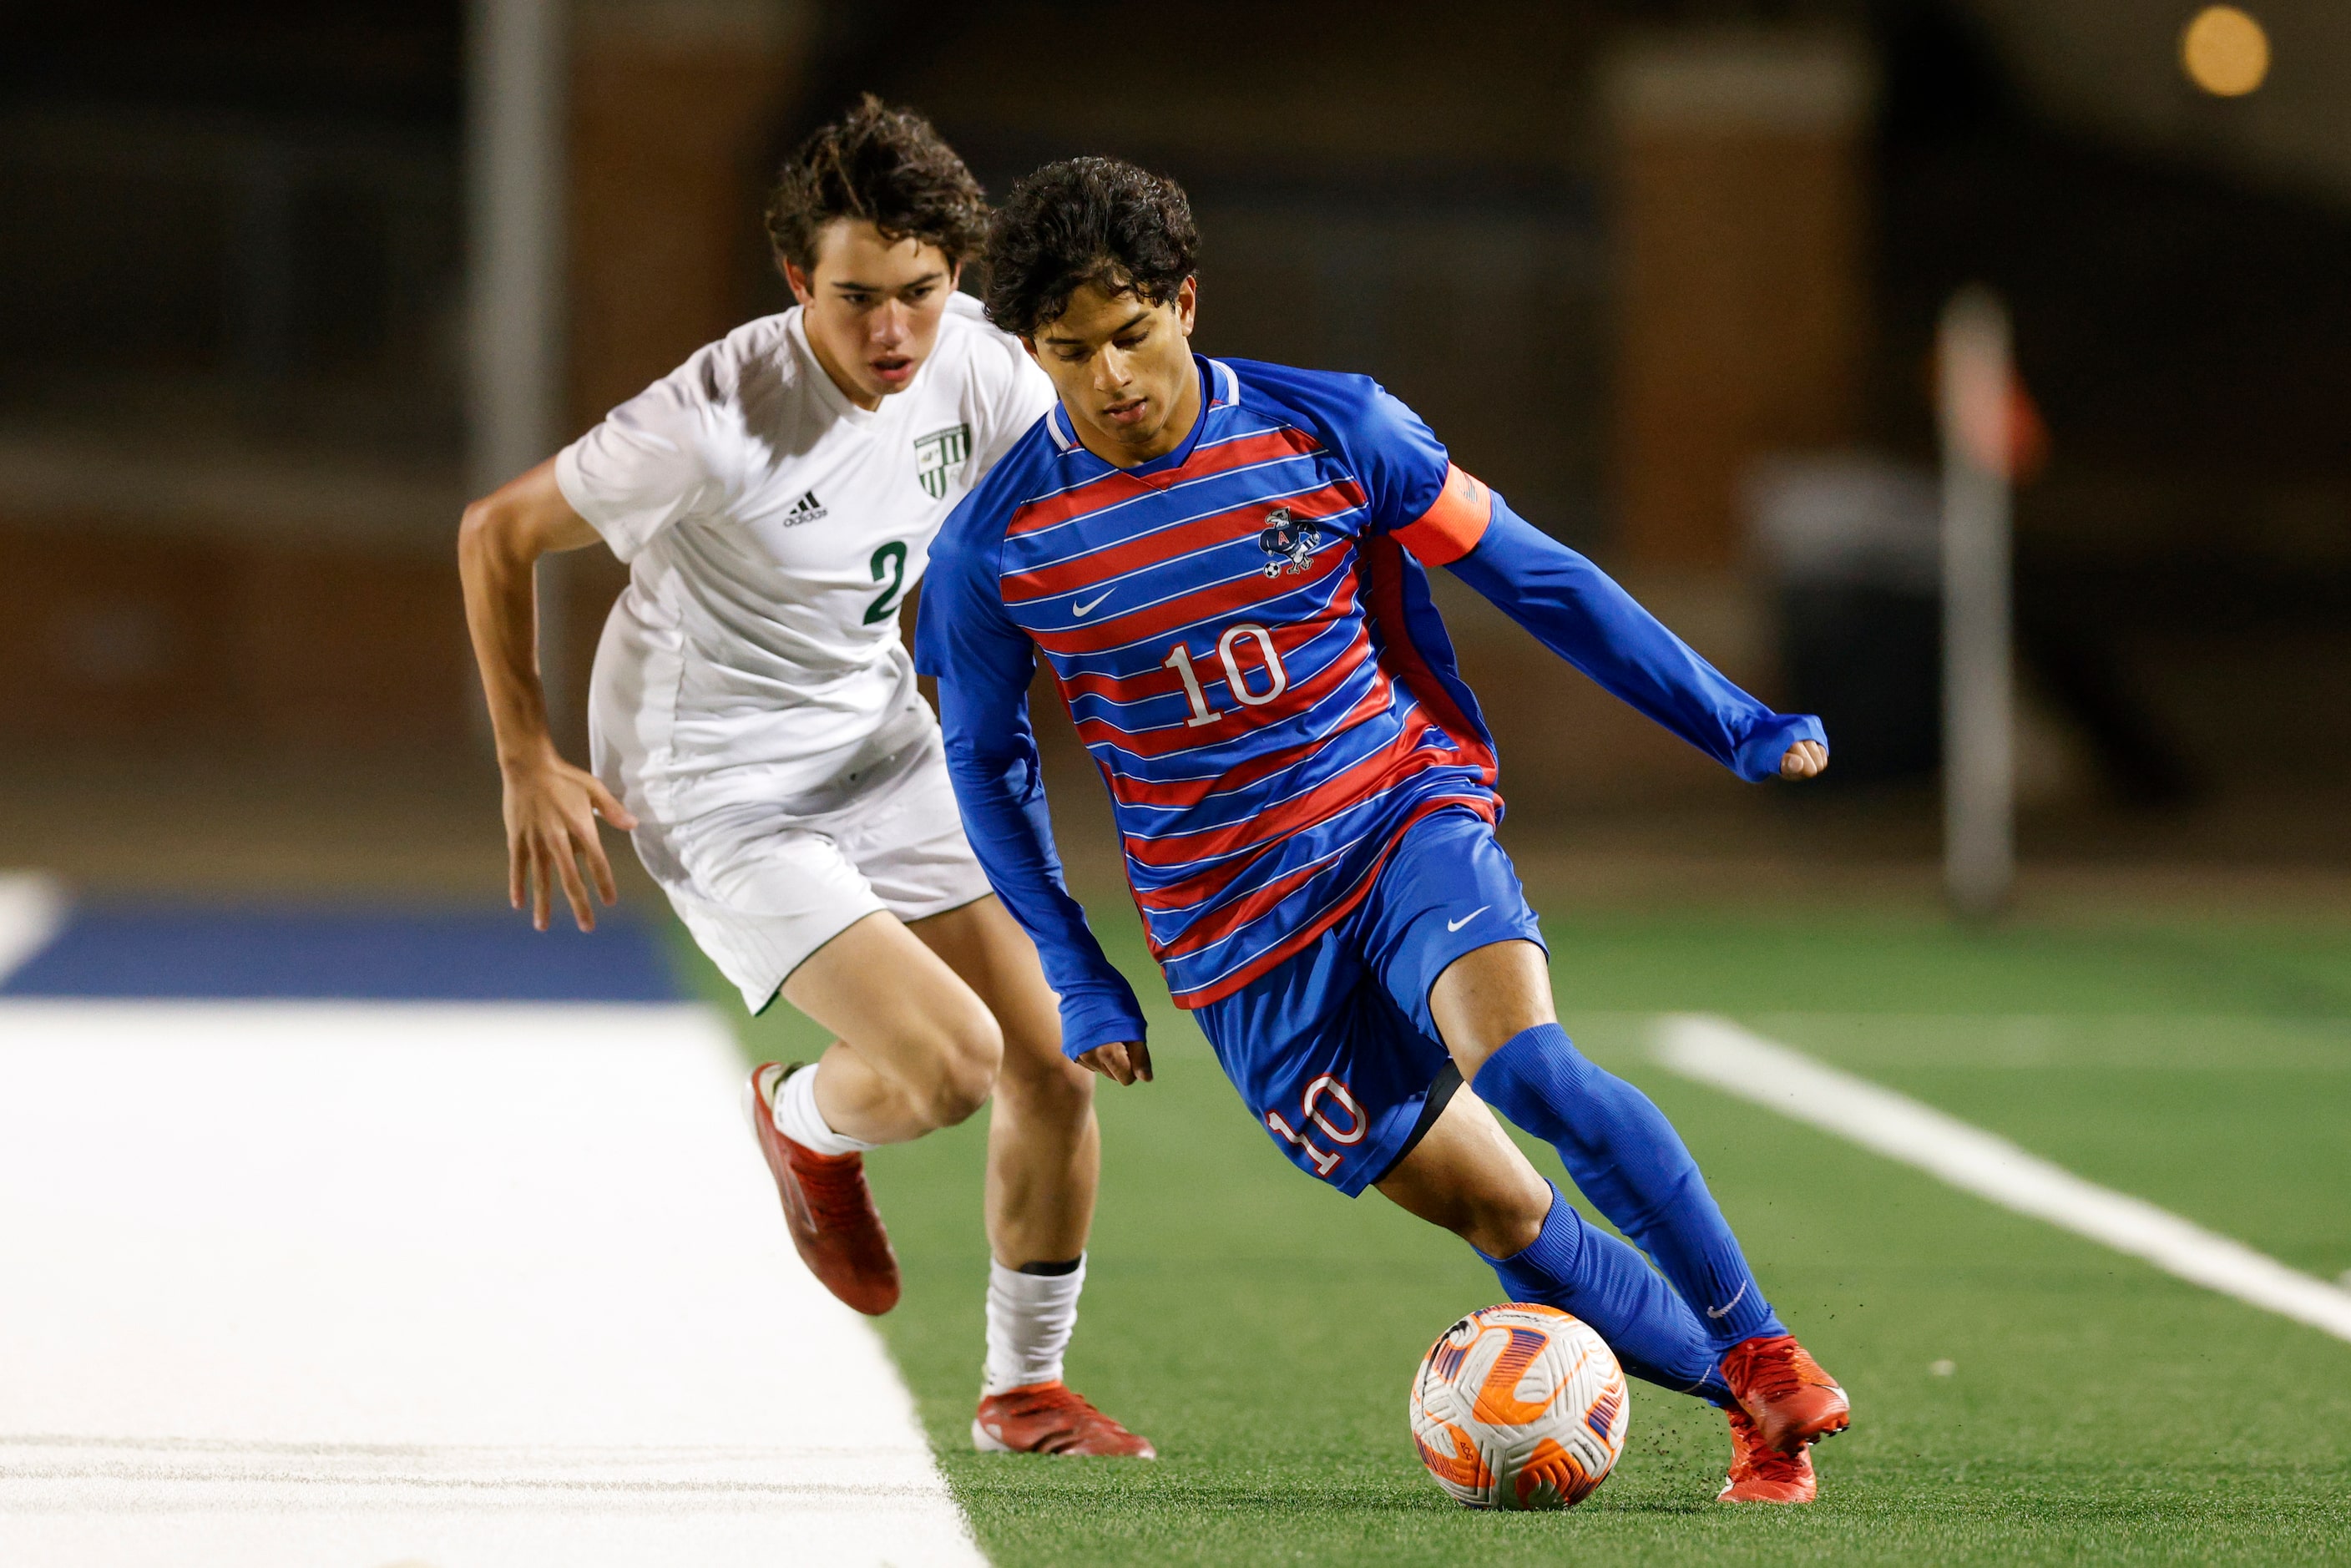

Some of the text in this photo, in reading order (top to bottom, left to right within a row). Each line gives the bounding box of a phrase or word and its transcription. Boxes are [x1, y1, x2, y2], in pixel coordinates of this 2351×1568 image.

[783, 508, 828, 528] adidas
[1278, 530, 1290, 546] A
[862, 540, 908, 626] 2
[1162, 622, 1288, 729] 10
[1267, 1075, 1368, 1176] 10
